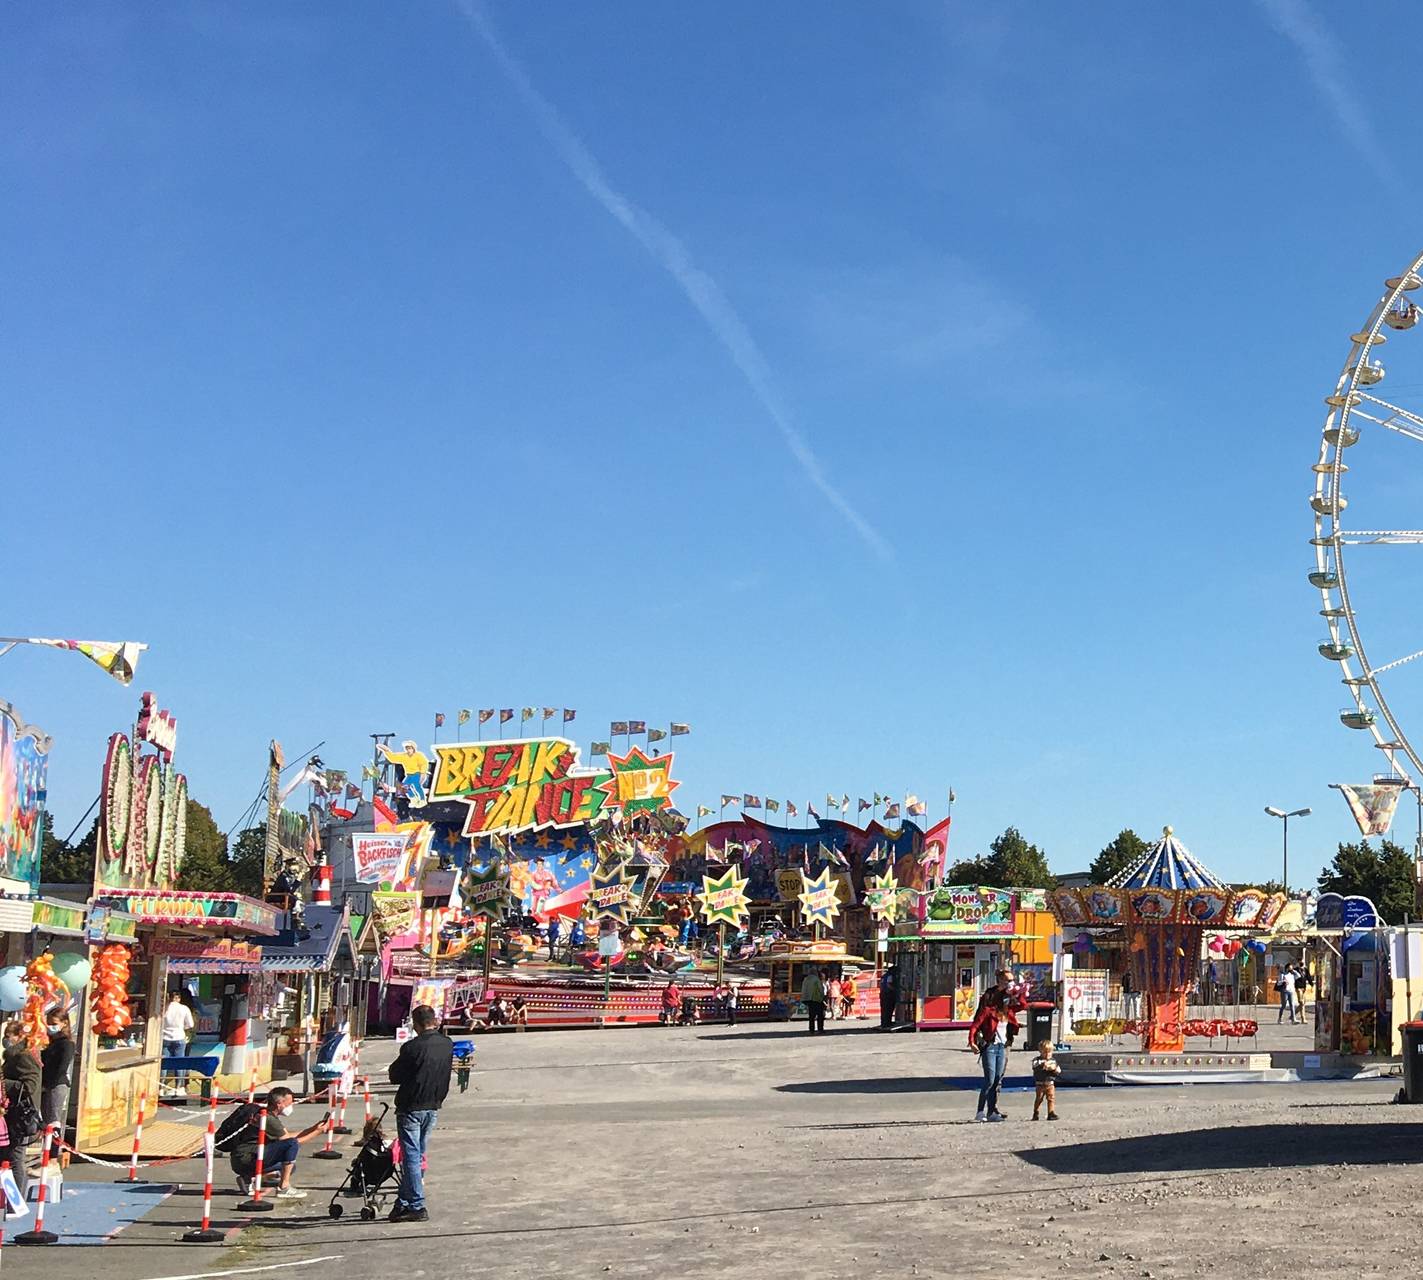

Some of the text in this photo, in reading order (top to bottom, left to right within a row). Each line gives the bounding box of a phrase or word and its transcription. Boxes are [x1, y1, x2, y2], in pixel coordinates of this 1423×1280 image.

[434, 740, 577, 797] BREAK
[465, 776, 597, 835] DANCE
[779, 879, 800, 892] STOP
[952, 892, 996, 904] MONSER
[130, 898, 205, 917] EUROPA
[956, 907, 989, 919] DROP
